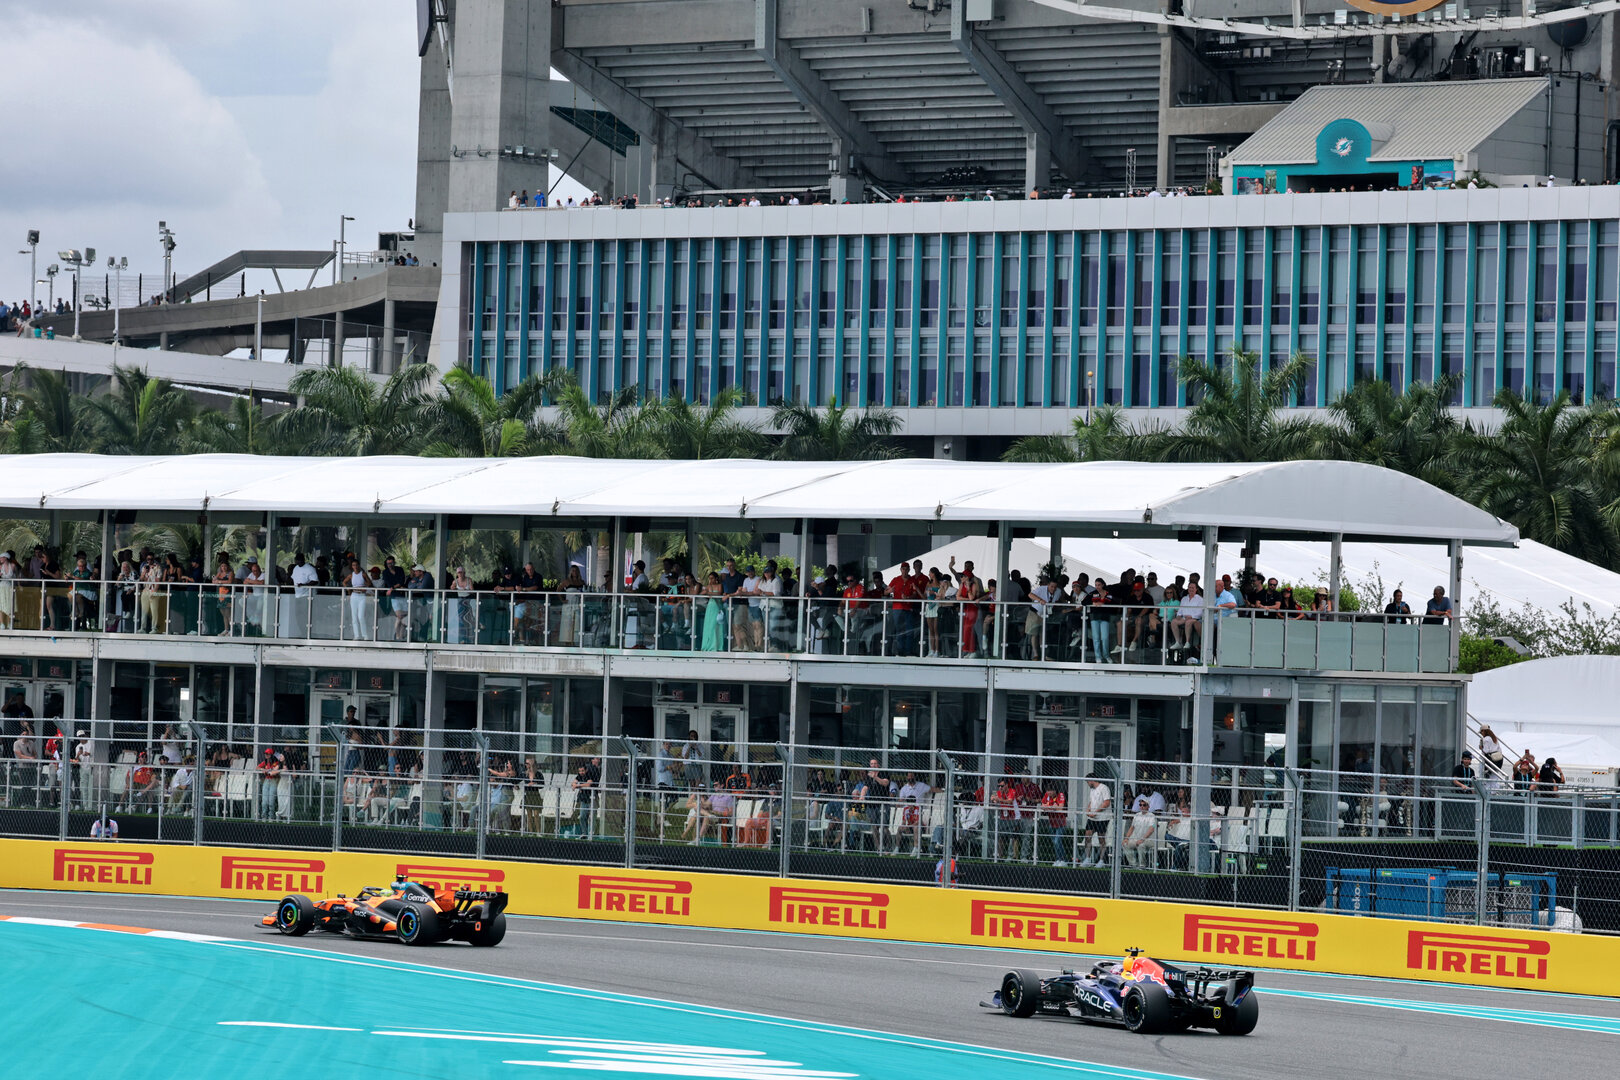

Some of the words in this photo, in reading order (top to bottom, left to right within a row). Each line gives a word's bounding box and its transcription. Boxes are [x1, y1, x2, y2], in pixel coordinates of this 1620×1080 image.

[53, 849, 154, 885] PIRELLI
[221, 856, 325, 893] PIRELLI
[407, 893, 429, 903] Gemini
[578, 875, 692, 916] PIRELLI
[769, 887, 889, 929] PIRELLI
[971, 900, 1097, 944] PIRELLI
[1183, 914, 1319, 961] PIRELLI
[1407, 930, 1550, 980] PIRELLI
[1185, 970, 1247, 981] ORACLE
[1073, 984, 1113, 1012] ORACLE
